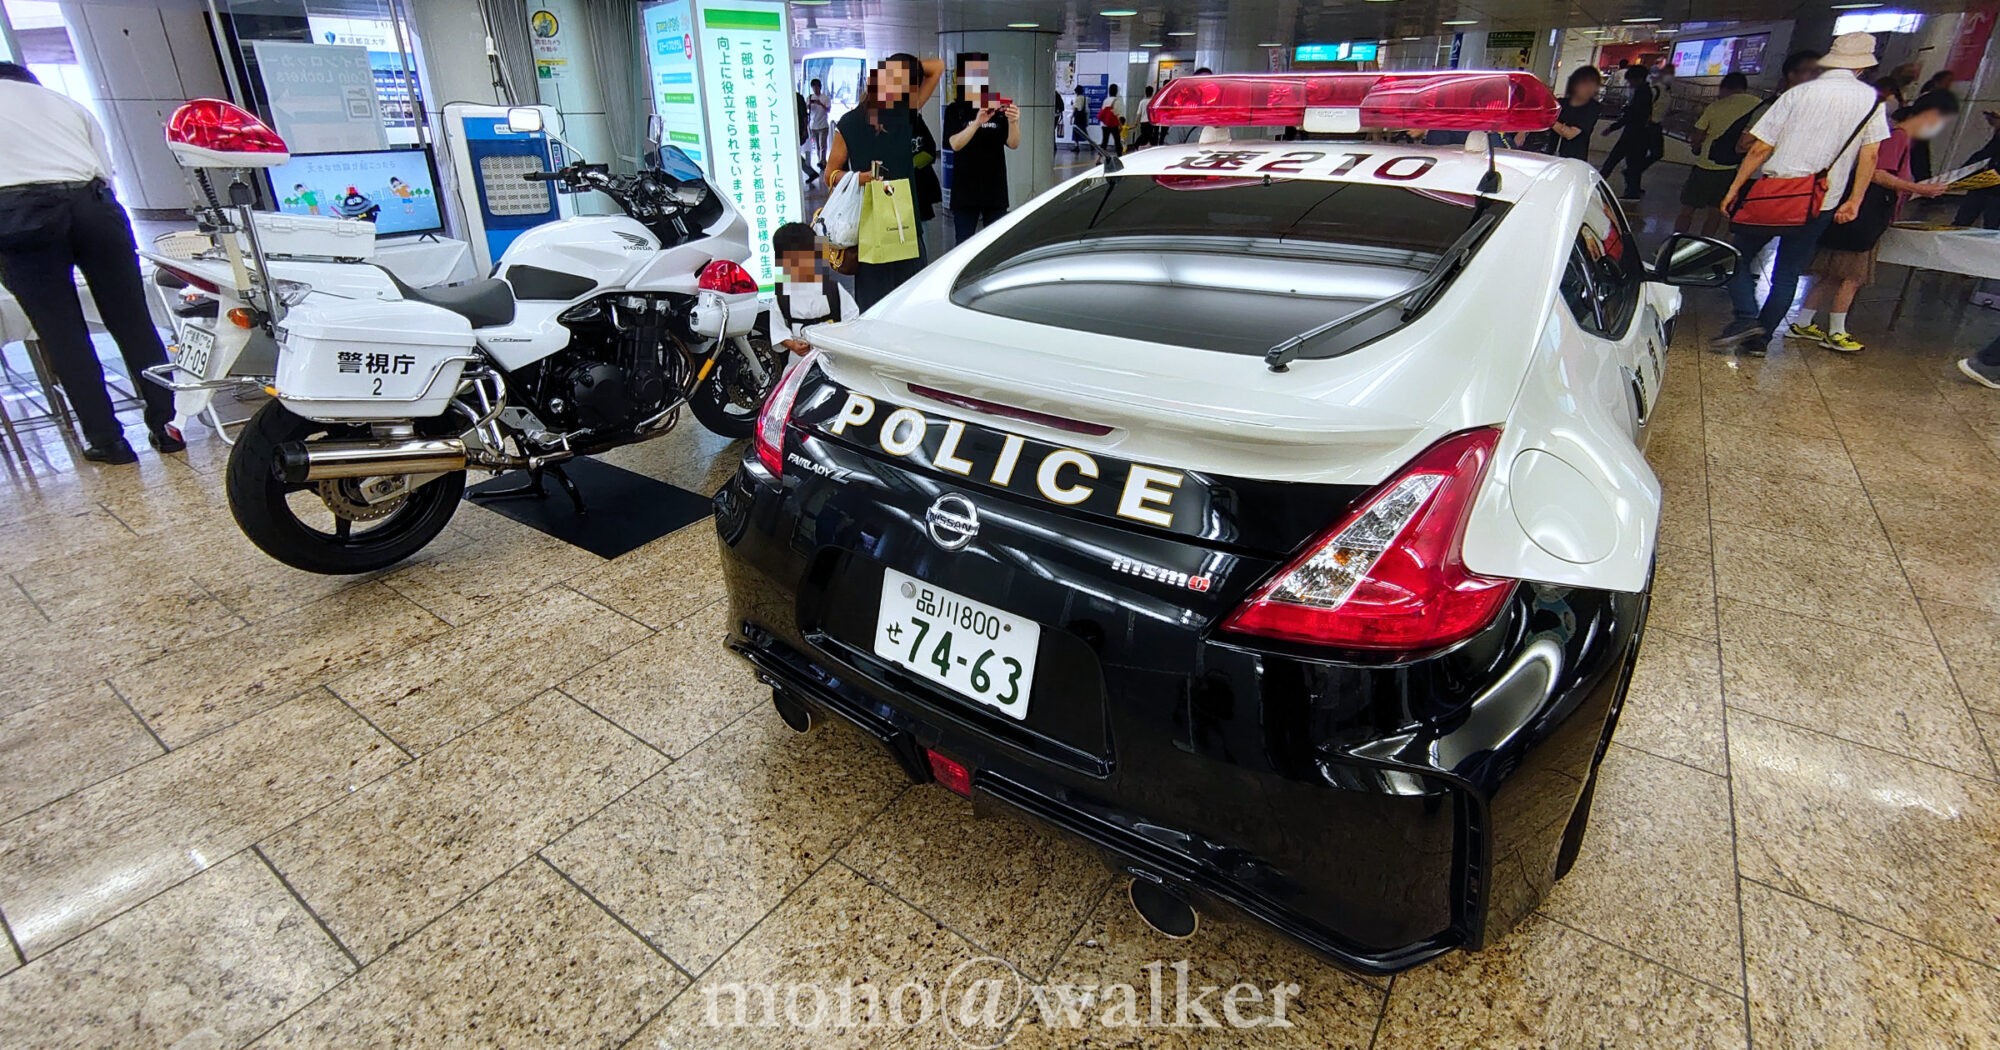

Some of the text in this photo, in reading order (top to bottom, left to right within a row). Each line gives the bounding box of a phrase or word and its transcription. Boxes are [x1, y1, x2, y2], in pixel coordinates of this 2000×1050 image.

[717, 36, 746, 210] 向上に役立てられています。
[739, 42, 773, 279] 一部は、福祉事業など都民の皆様の生活
[763, 39, 788, 227] このイベントコーナーにおける
[337, 351, 416, 375] 警視庁
[372, 378, 383, 396] 2
[787, 452, 836, 477] FAIRLADY
[831, 392, 1184, 528] POLICE
[928, 511, 973, 532] NISSAN
[886, 617, 1023, 706] せ 74-63
